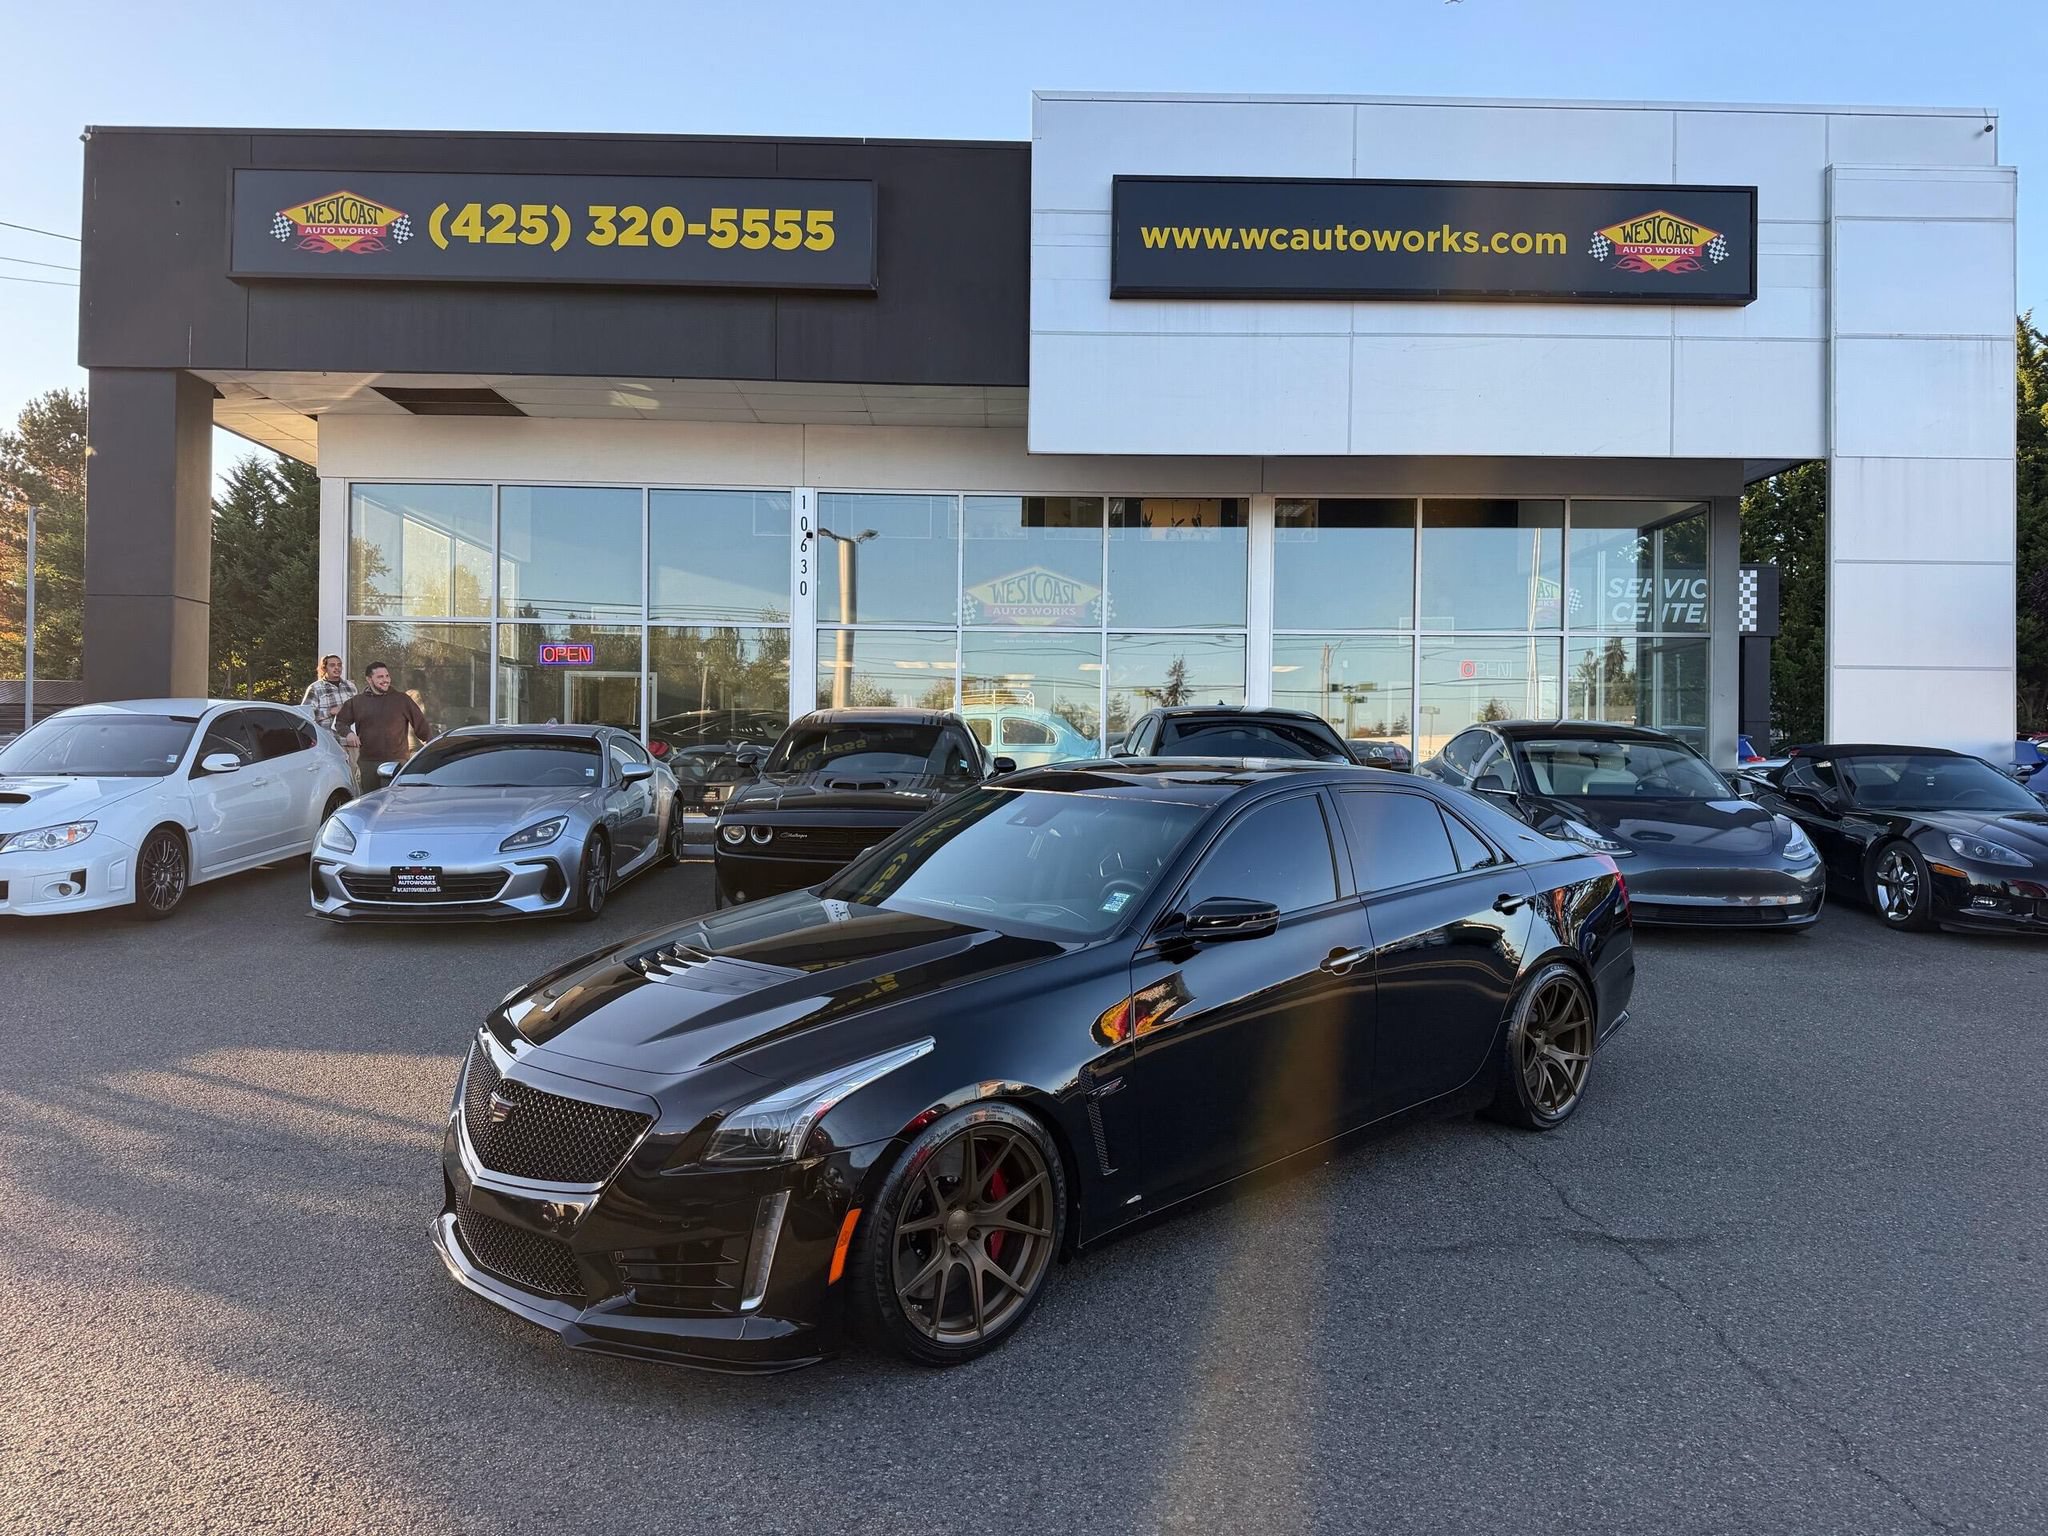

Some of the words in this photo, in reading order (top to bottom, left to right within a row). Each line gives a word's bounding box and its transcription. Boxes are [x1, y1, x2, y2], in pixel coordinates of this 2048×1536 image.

[305, 226, 336, 235] AUTO
[338, 227, 379, 235] WORKS
[428, 202, 572, 253] (425)
[585, 205, 836, 252] 320-5555
[1140, 225, 1568, 256] www.wcautoworks.com
[1622, 246, 1653, 255] AUTO
[1655, 246, 1695, 255] WORKS
[992, 607, 1028, 616] AUTO
[1031, 607, 1077, 616] WORKS
[1612, 601, 1707, 623] CENTE
[543, 646, 591, 662] OPEN
[1461, 659, 1509, 677] OPEN
